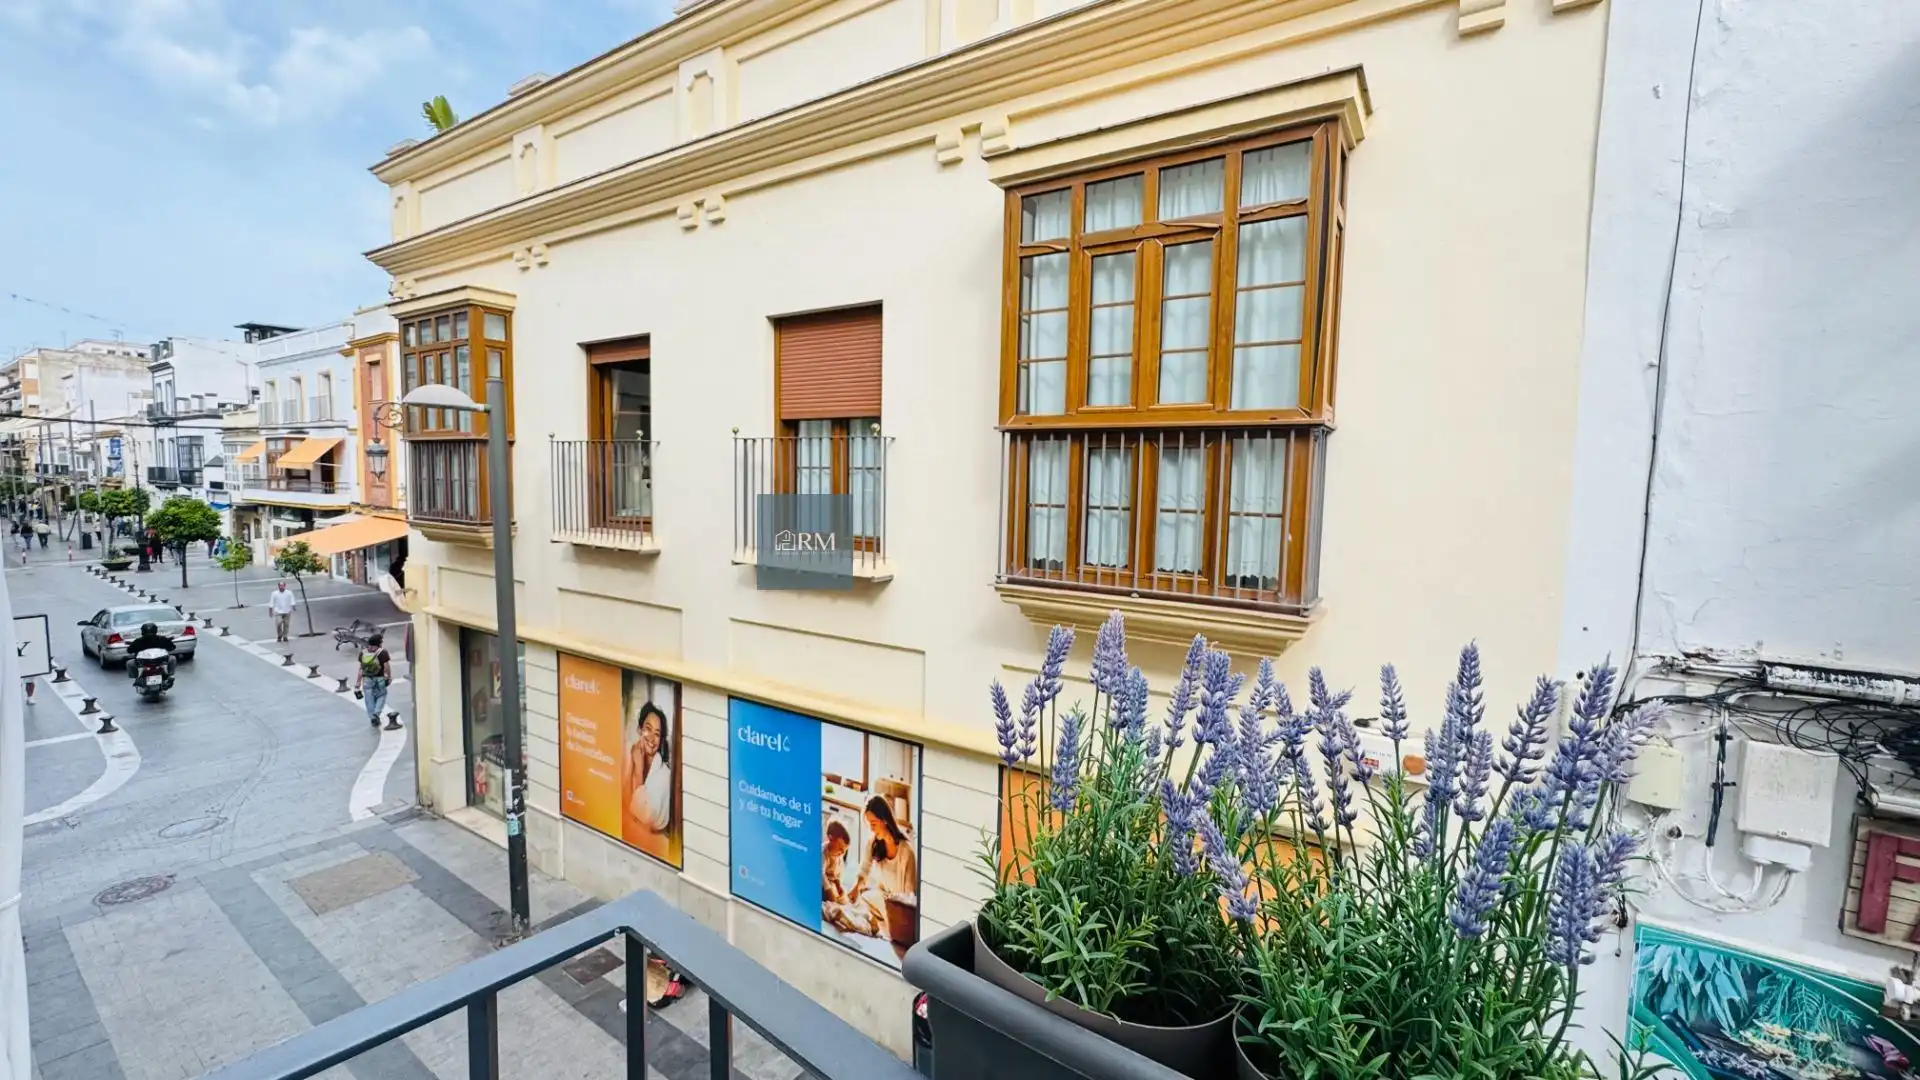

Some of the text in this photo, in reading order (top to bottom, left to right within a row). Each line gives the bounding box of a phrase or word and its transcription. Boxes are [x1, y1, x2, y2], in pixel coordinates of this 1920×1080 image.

[736, 725, 783, 752] clarel
[738, 780, 788, 806] Cuidamos
[788, 796, 802, 812] de
[746, 800, 759, 813] de
[760, 804, 772, 819] tu
[772, 807, 804, 829] hogar
